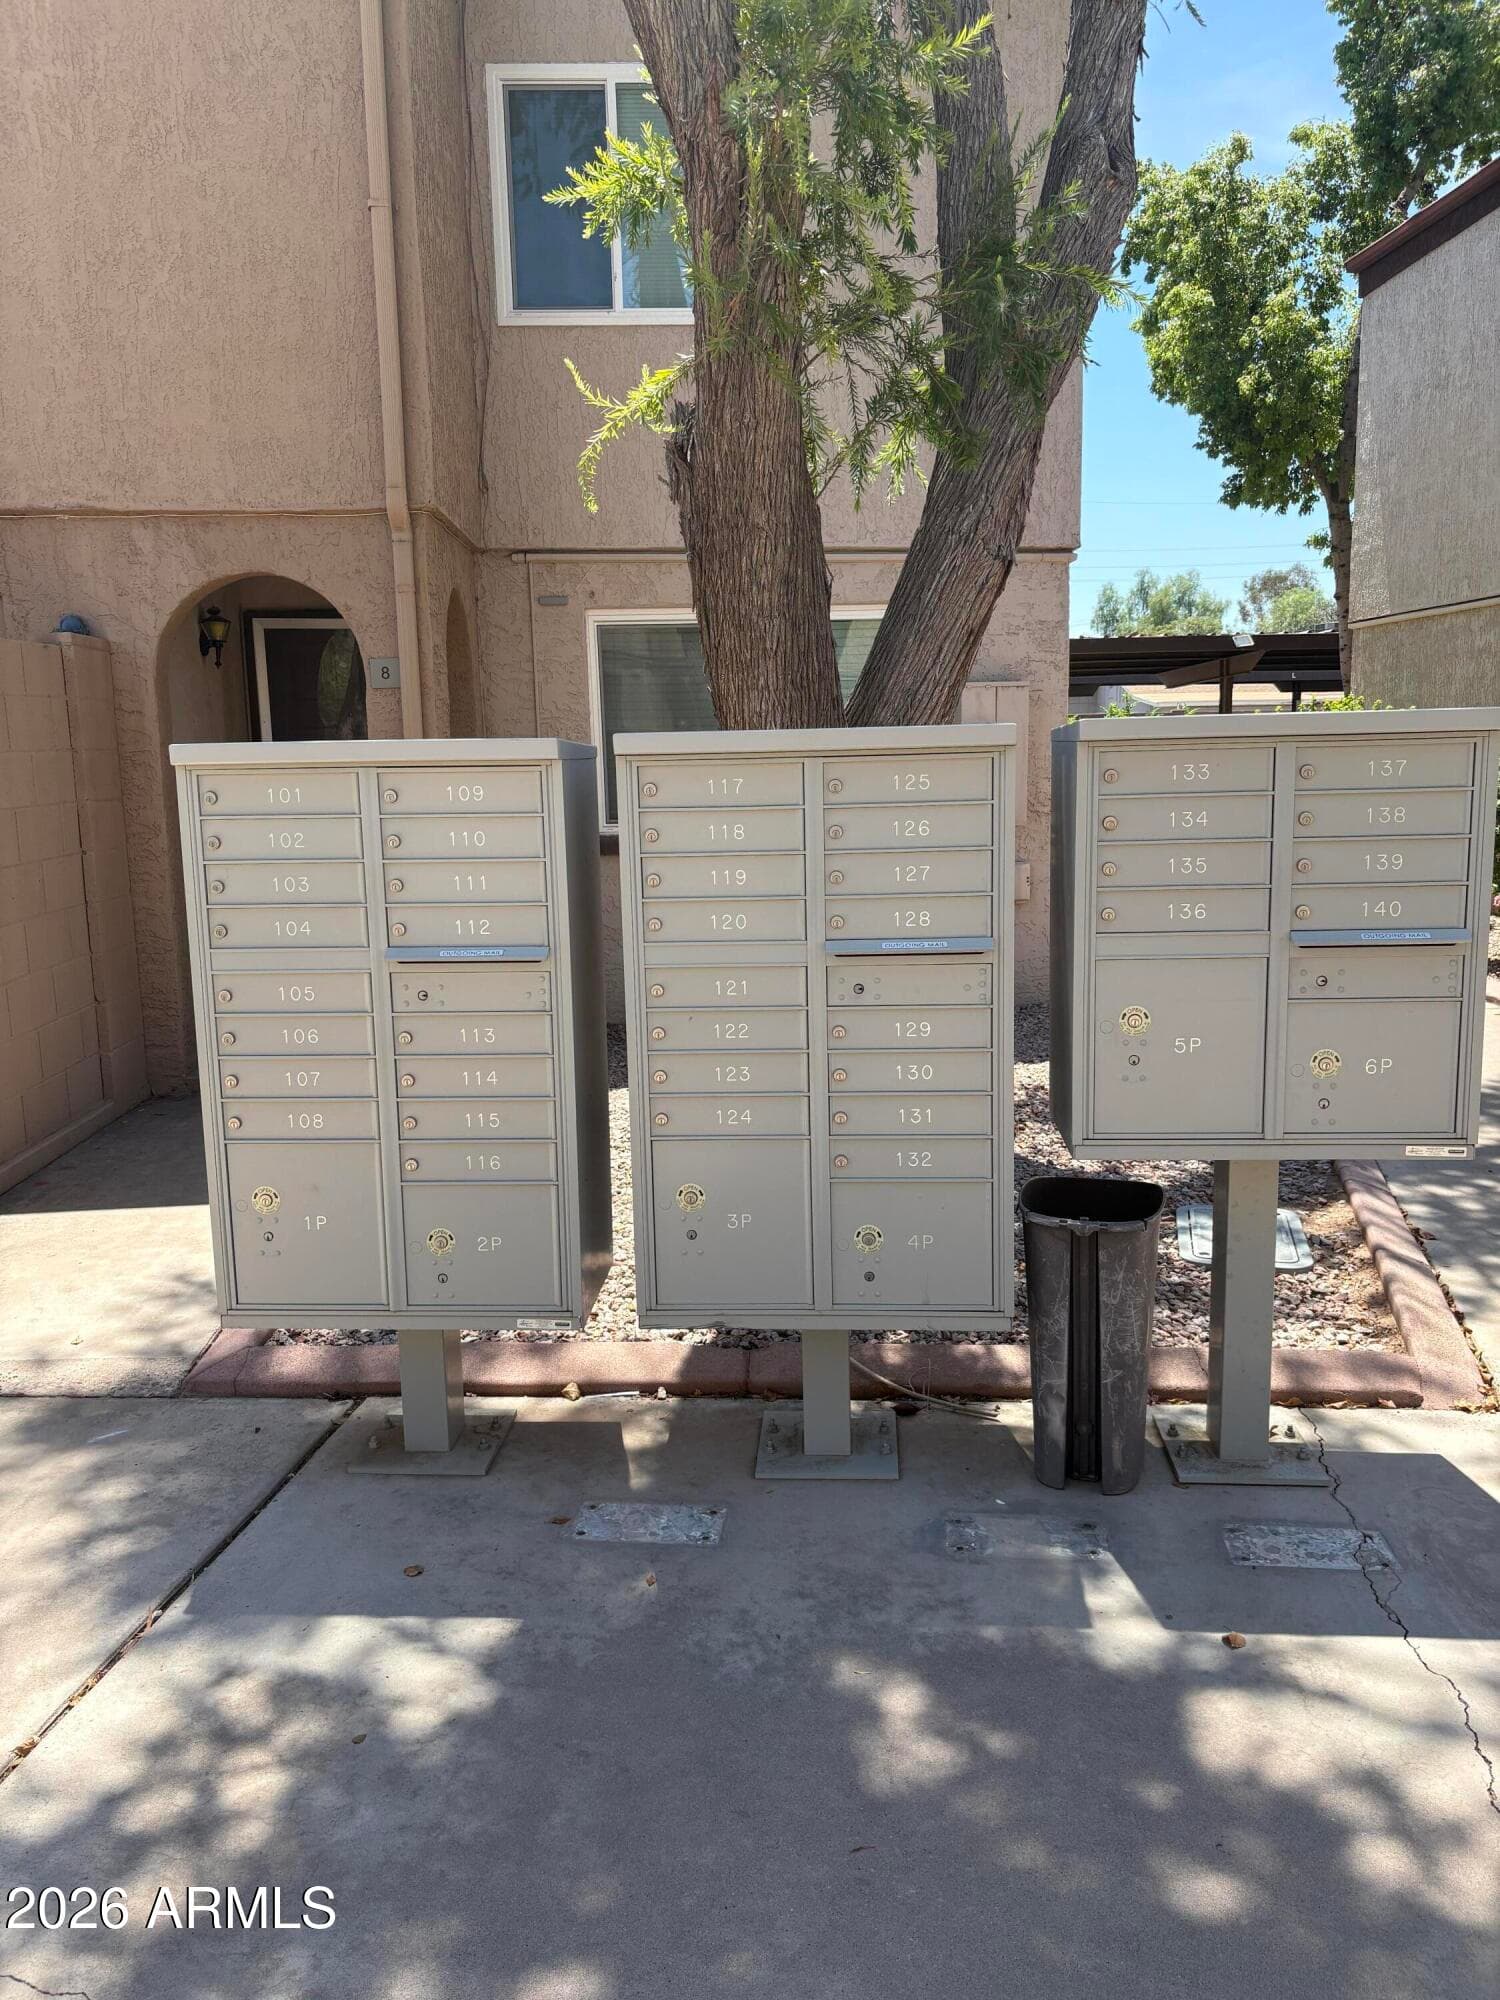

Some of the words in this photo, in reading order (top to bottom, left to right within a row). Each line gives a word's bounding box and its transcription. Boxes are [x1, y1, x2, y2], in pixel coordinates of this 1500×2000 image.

[381, 666, 390, 680] 8
[1171, 763, 1210, 781] 133
[1368, 759, 1408, 777] 137
[707, 778, 745, 795] 117
[893, 773, 931, 791] 125
[267, 787, 301, 804] 101
[446, 785, 484, 802] 109
[1169, 810, 1209, 829] 134
[1367, 806, 1407, 824] 138
[708, 823, 745, 841] 118
[892, 819, 930, 837] 126
[268, 832, 305, 849] 102
[449, 830, 486, 848] 110
[1168, 857, 1208, 874] 135
[1364, 853, 1403, 871] 139
[711, 869, 747, 886] 119
[894, 865, 931, 882] 127
[272, 876, 310, 893] 103
[453, 874, 487, 891] 111
[1167, 903, 1208, 920] 136
[1362, 900, 1402, 918] 140
[455, 919, 492, 936] 112
[710, 913, 747, 930] 120
[893, 910, 931, 928] 128
[274, 920, 312, 937] 104
[278, 985, 315, 1002] 105
[715, 979, 747, 996] 121
[280, 1028, 319, 1044] 106
[459, 1027, 496, 1044] 113
[713, 1023, 750, 1039] 122
[895, 1021, 931, 1038] 129
[1173, 1037, 1202, 1054] 5P
[715, 1065, 751, 1082] 123
[895, 1064, 933, 1081] 130
[1364, 1057, 1393, 1075] 6P
[284, 1071, 321, 1087] 107
[462, 1070, 499, 1087] 114
[287, 1113, 324, 1129] 108
[465, 1112, 500, 1129] 115
[715, 1109, 753, 1126] 124
[898, 1108, 932, 1125] 131
[465, 1154, 501, 1170] 116
[896, 1151, 933, 1168] 132
[303, 1215, 327, 1231] 1P
[727, 1213, 752, 1229] 3P
[476, 1236, 502, 1252] 2P
[907, 1234, 934, 1250] 4P
